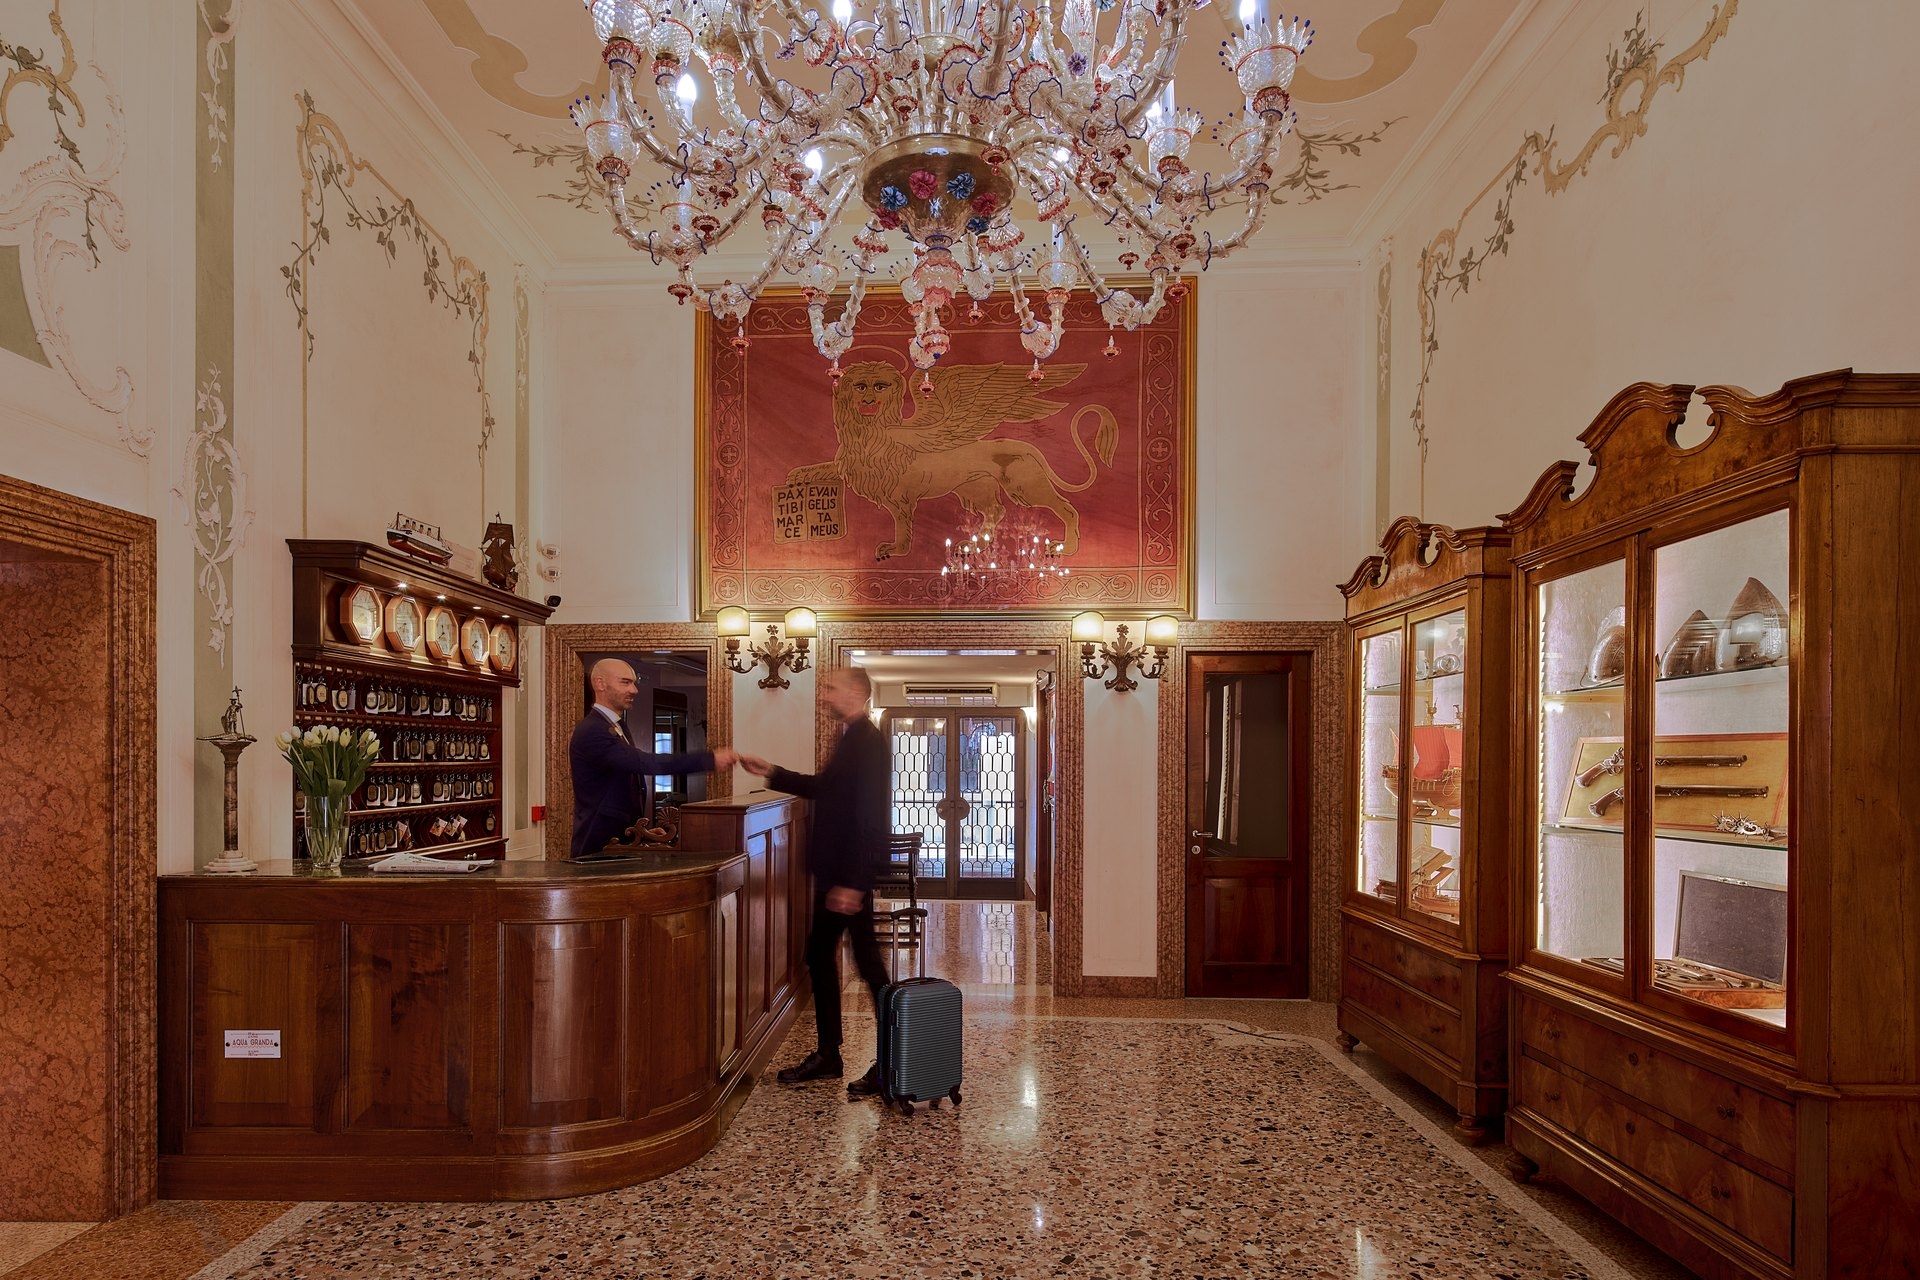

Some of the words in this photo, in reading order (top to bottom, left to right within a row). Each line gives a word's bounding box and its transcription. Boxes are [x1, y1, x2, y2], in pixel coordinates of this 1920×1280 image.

[778, 488, 804, 502] PAX
[809, 487, 838, 497] EVAN
[778, 501, 803, 515] TIBI
[808, 499, 836, 510] GELIS
[777, 514, 804, 528] MAR
[817, 512, 832, 522] TA
[785, 527, 800, 538] CE
[810, 524, 838, 537] MEUS
